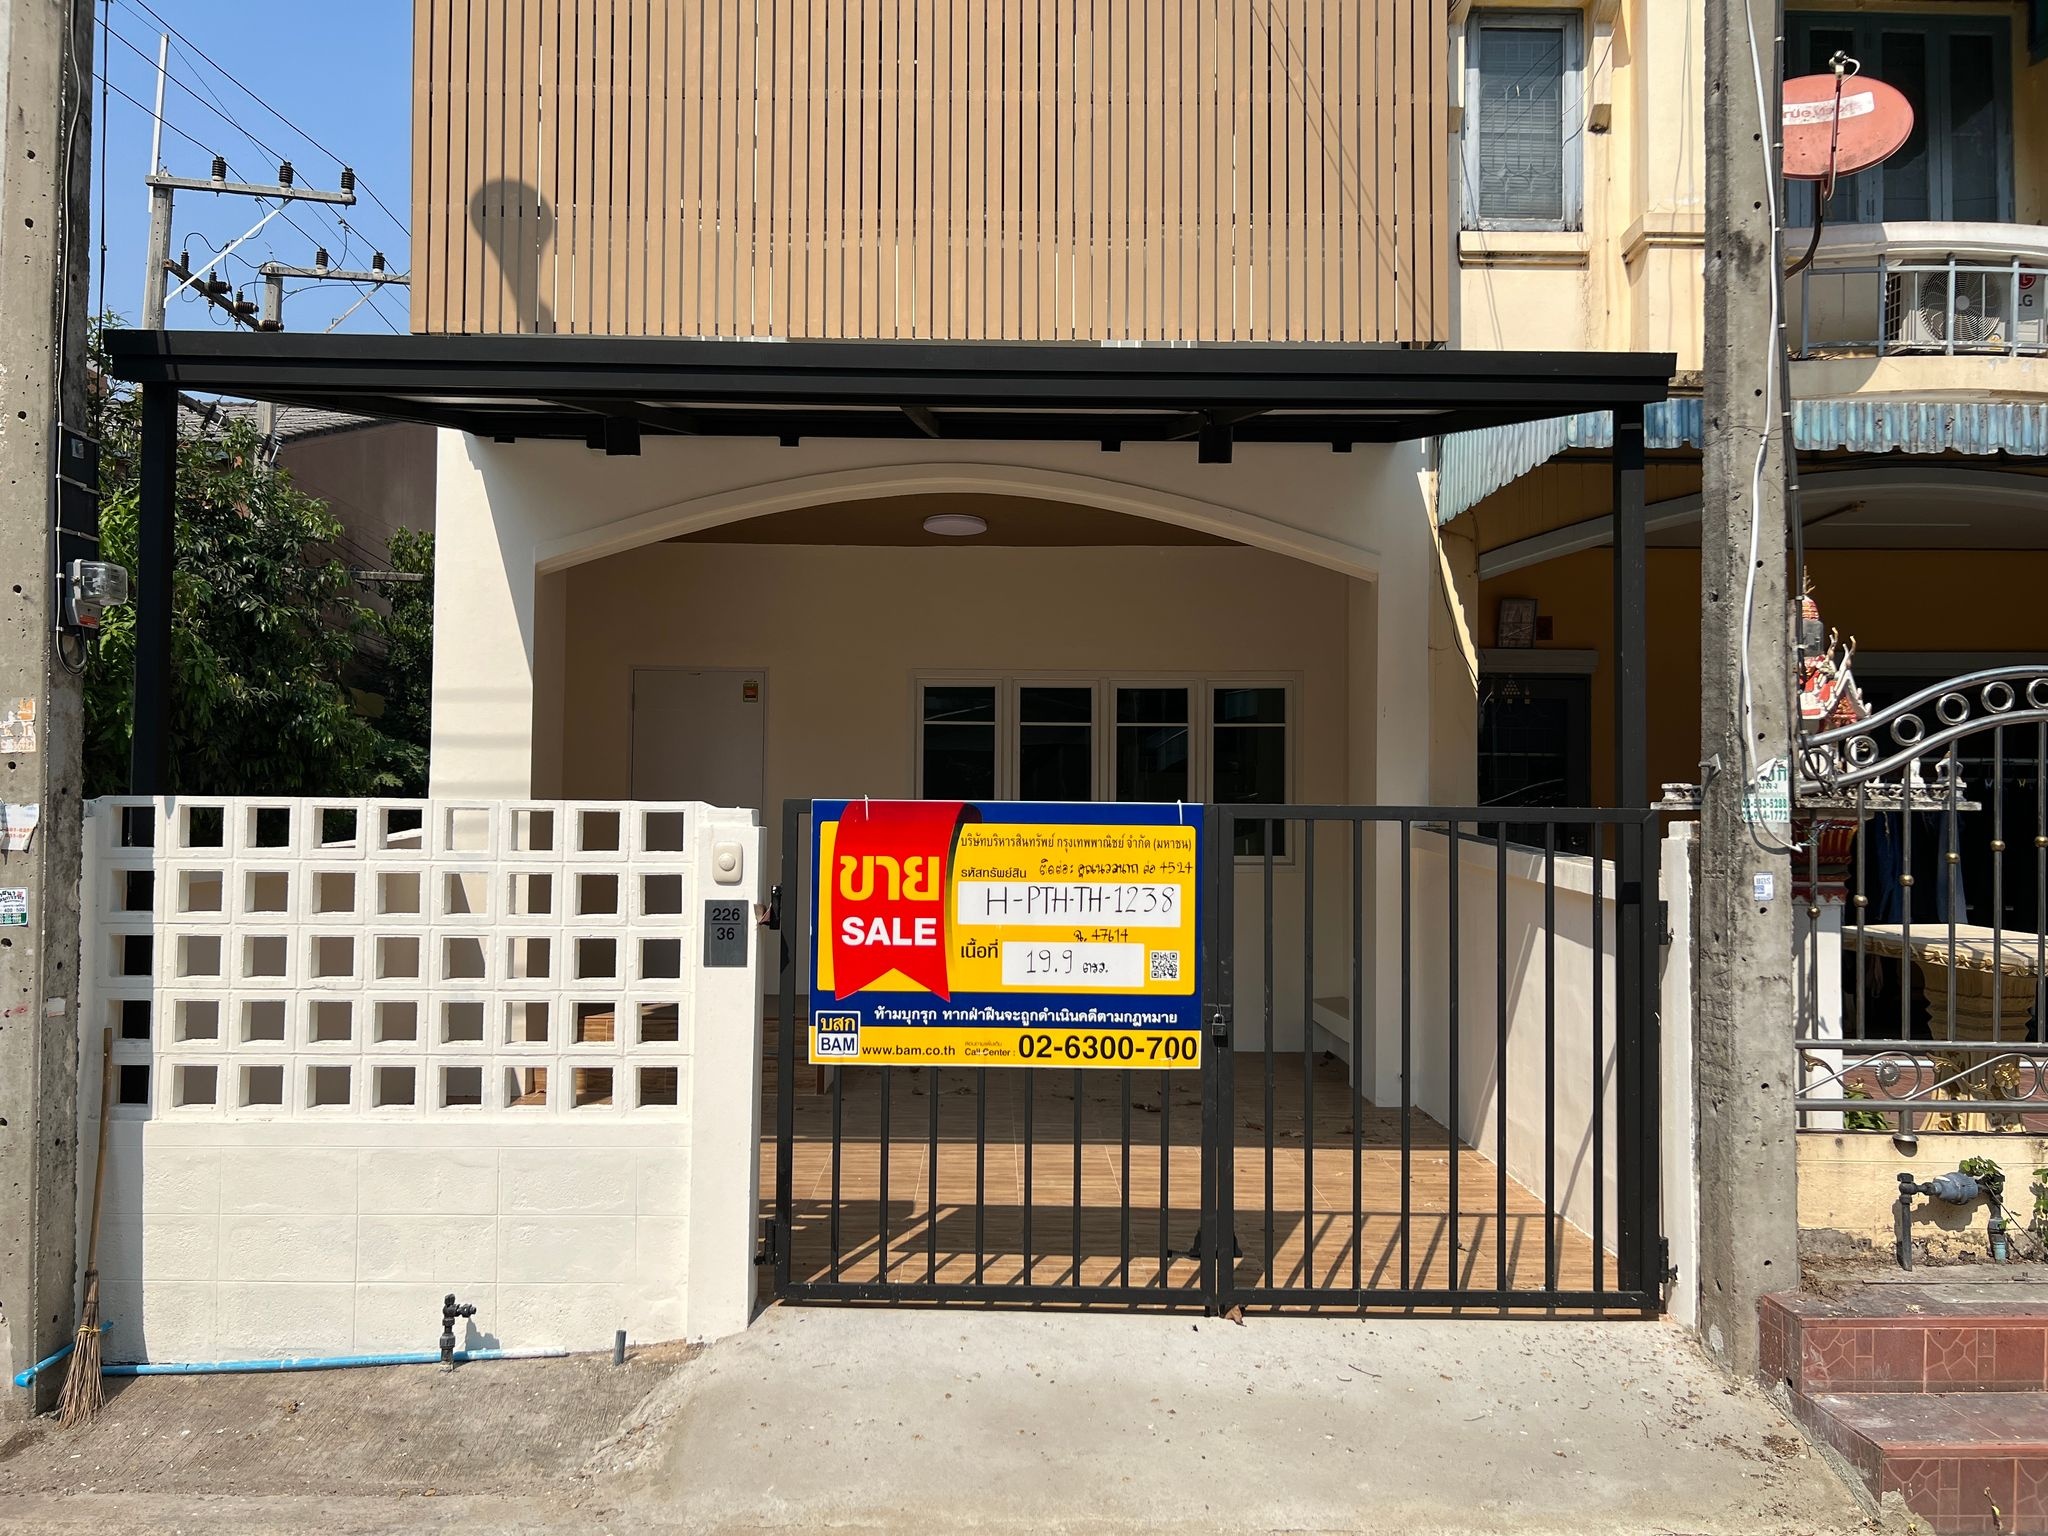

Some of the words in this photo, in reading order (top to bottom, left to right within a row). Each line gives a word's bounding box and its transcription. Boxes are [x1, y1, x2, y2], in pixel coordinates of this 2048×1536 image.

[2018, 293, 2033, 307] G
[960, 832, 1055, 848] บริษัทบริหารสินทรัพย์
[1057, 833, 1125, 852] กรุงเทพพาณิชย์
[1126, 835, 1151, 849] จำกัด
[1153, 837, 1192, 851] (มหาชน)
[839, 855, 940, 901] ขาย
[960, 866, 1027, 879] รหัสทรัพย์สิน
[712, 907, 741, 921] 226
[717, 927, 735, 940] 36
[841, 916, 937, 946] SALE
[1091, 928, 1129, 943] 47614
[960, 938, 999, 959] เนื้อที่
[1026, 949, 1073, 974] 19.9
[820, 1015, 856, 1031] บสก
[874, 1005, 937, 1025] ห้ามบุกรุก
[942, 1006, 1178, 1026] หากฝ่าฝืนจะถูกดำเนินคดีตามกฎหมาย
[821, 1037, 855, 1051] BAM
[862, 1045, 956, 1056] www.bam.co.th
[982, 1047, 1011, 1057] Center
[1018, 1034, 1198, 1061] 02-6300-700
